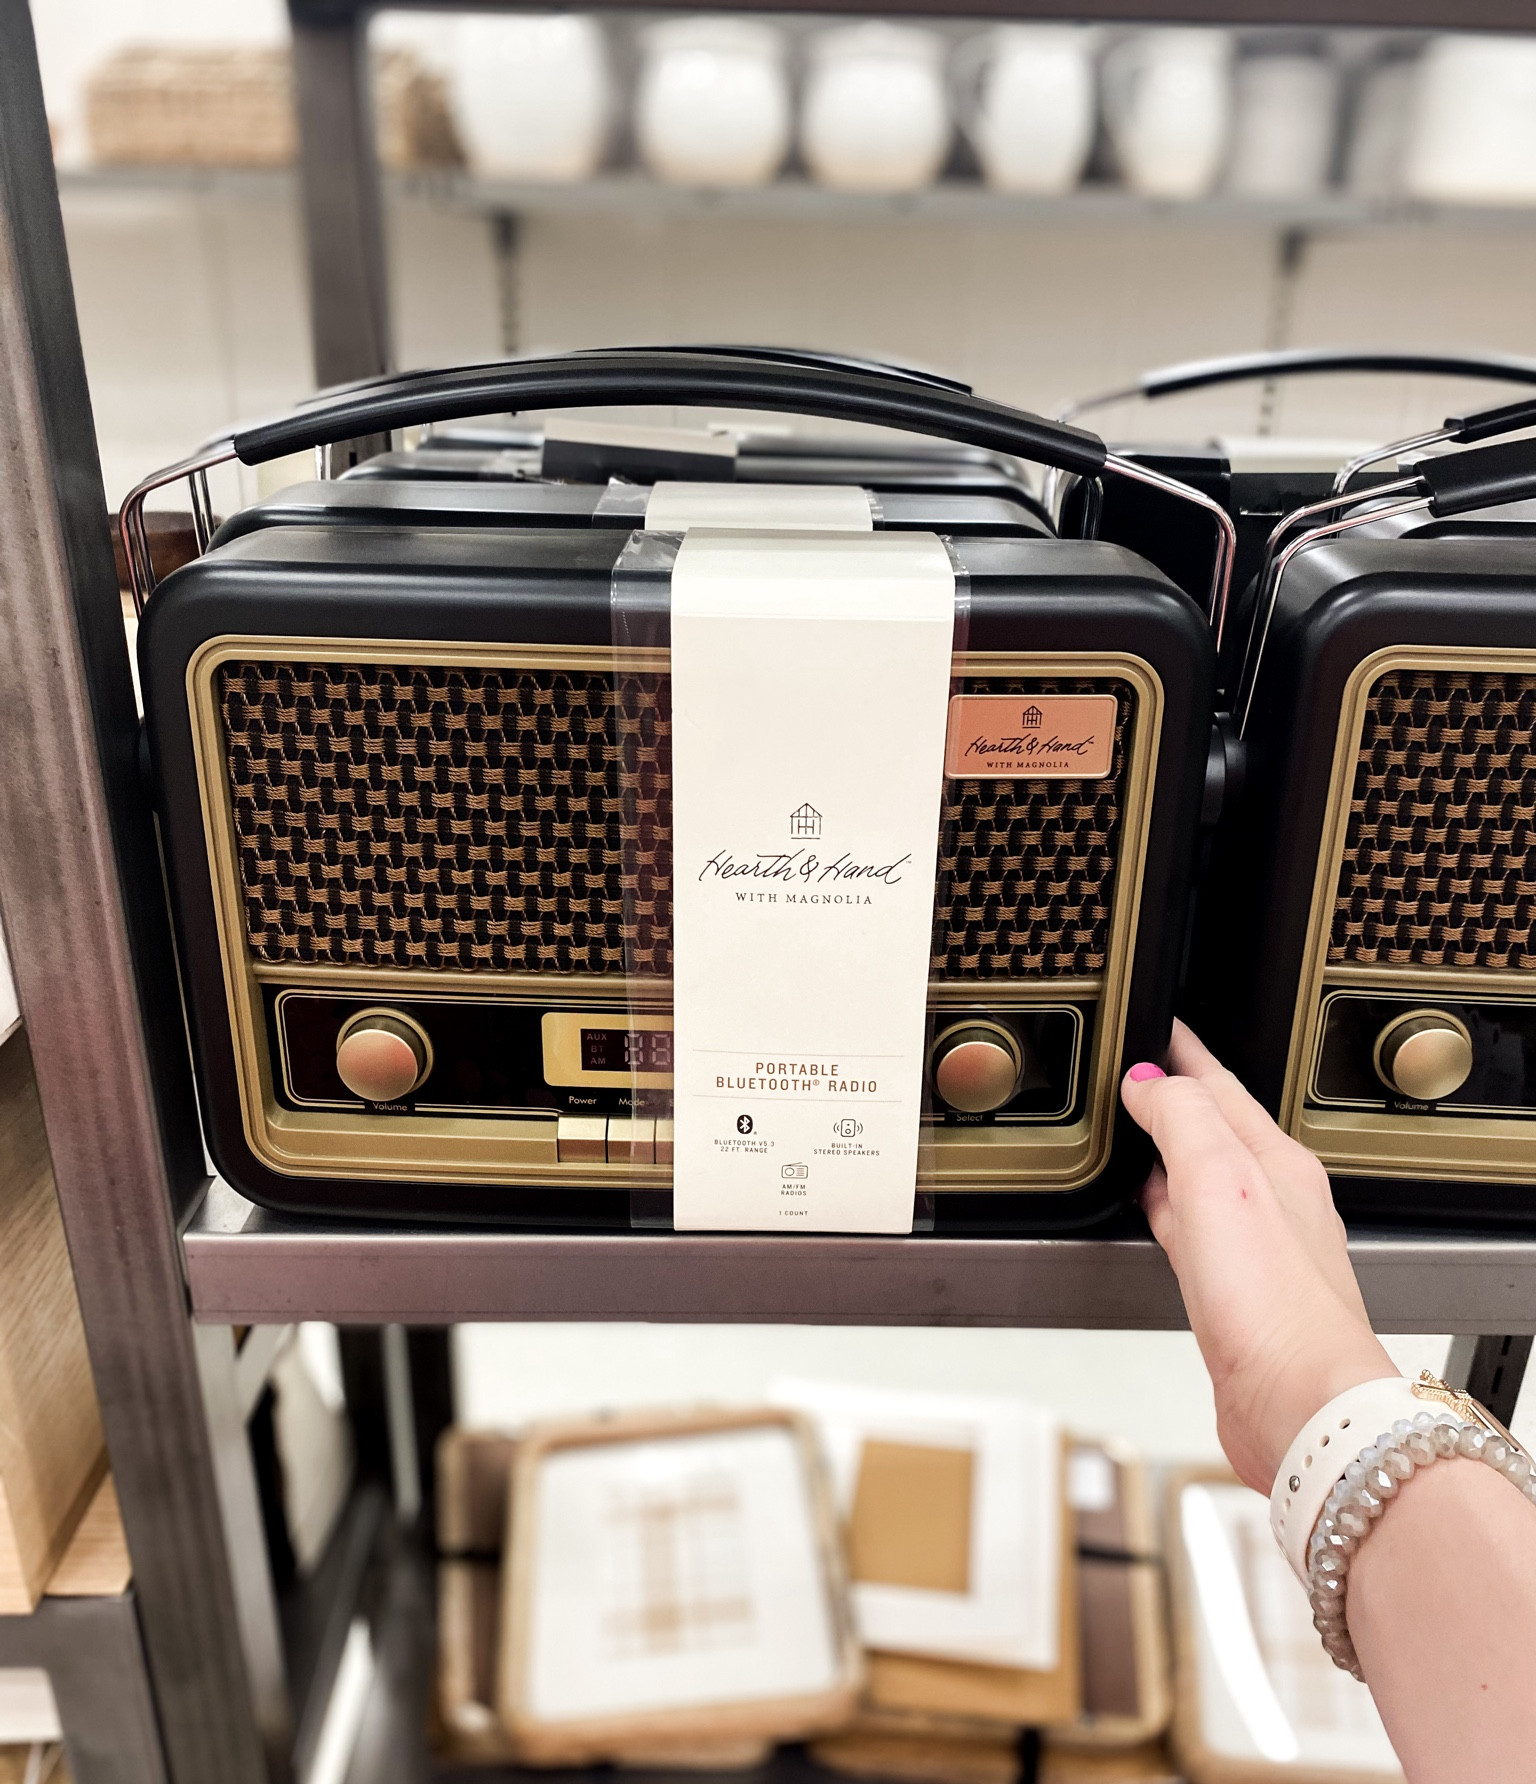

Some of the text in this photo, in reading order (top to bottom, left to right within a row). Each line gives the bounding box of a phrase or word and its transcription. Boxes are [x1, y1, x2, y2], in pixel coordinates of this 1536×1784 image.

[965, 733, 1032, 756] Hearth
[1026, 737, 1039, 755] &
[698, 849, 805, 881] Hearth
[799, 855, 819, 882] &
[736, 892, 872, 904] WITH MAGNOLIA
[755, 1062, 839, 1076] PORTABLE
[828, 1080, 877, 1092] RADIO
[568, 1096, 597, 1104] Power
[618, 1098, 645, 1106] Mode
[372, 1102, 408, 1111] Volume
[1394, 1101, 1428, 1110] Volume
[956, 1113, 983, 1121] Select
